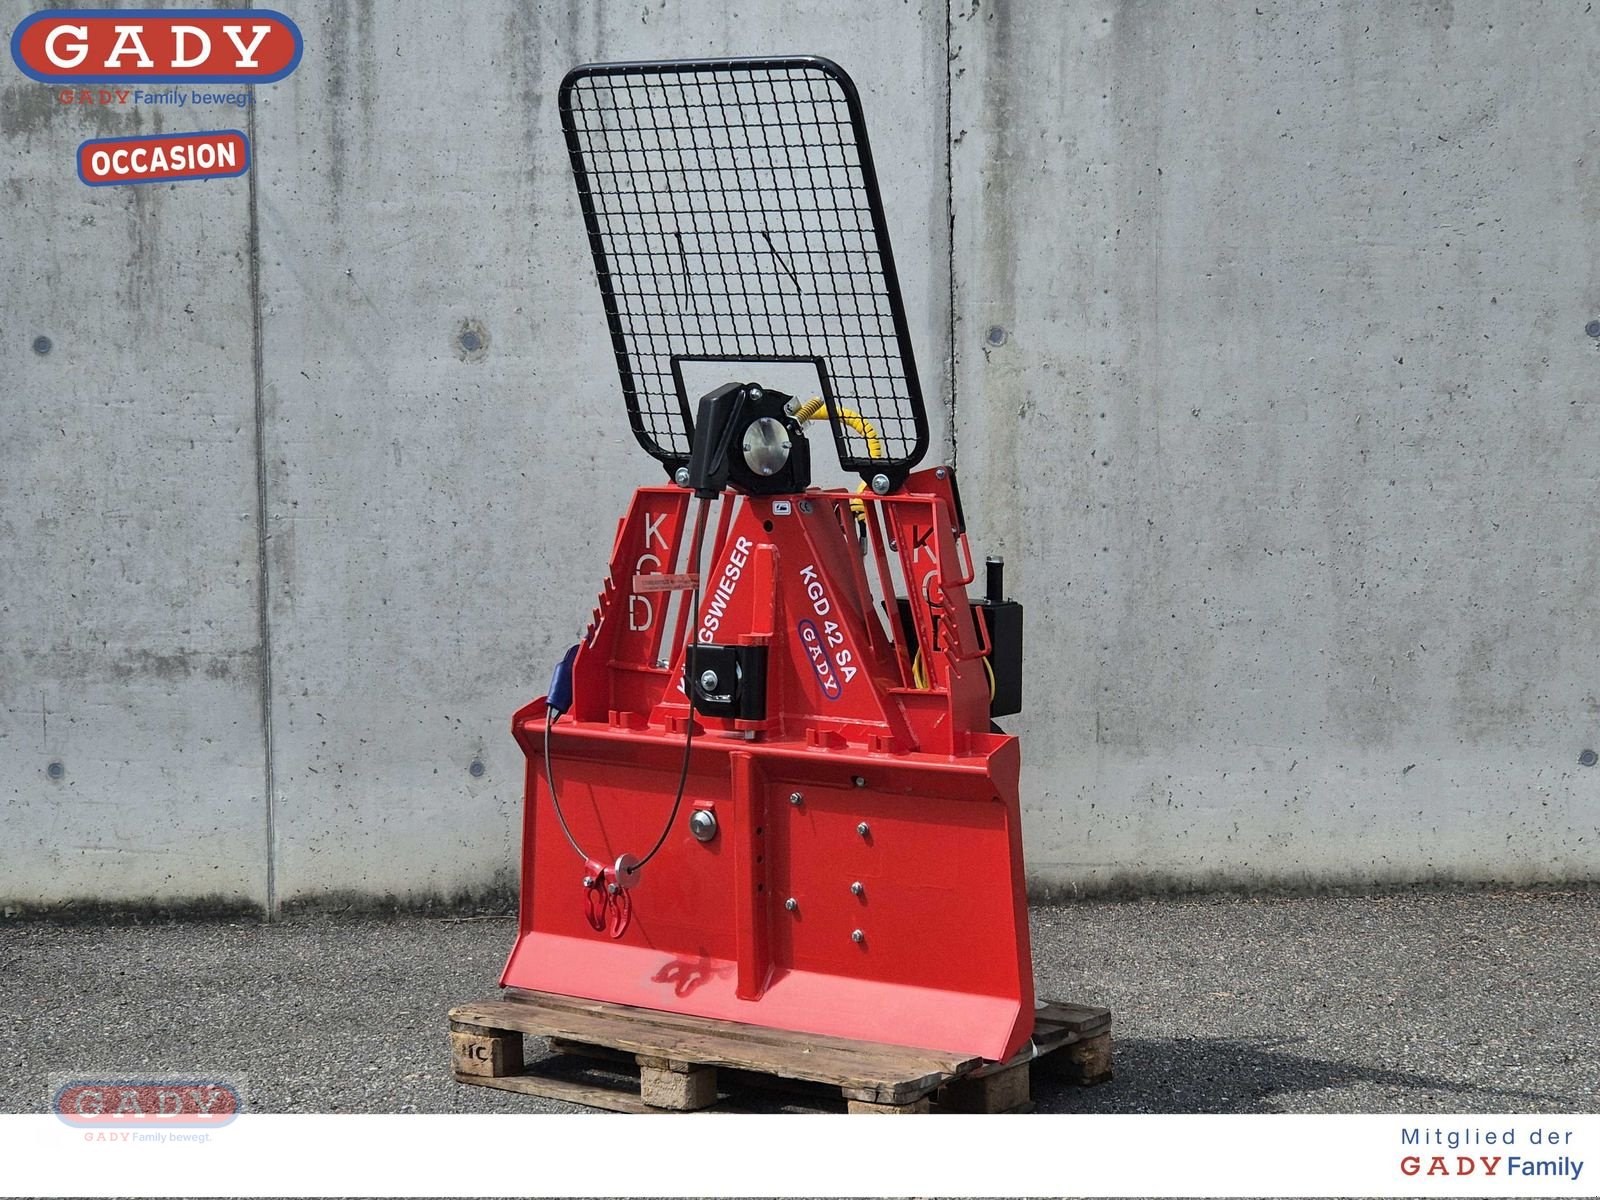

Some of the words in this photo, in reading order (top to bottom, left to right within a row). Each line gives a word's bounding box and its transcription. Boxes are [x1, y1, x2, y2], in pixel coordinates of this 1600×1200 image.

[800, 565, 830, 616] KGD
[824, 620, 844, 648] 42
[835, 649, 857, 683] SA
[803, 628, 837, 690] GADY
